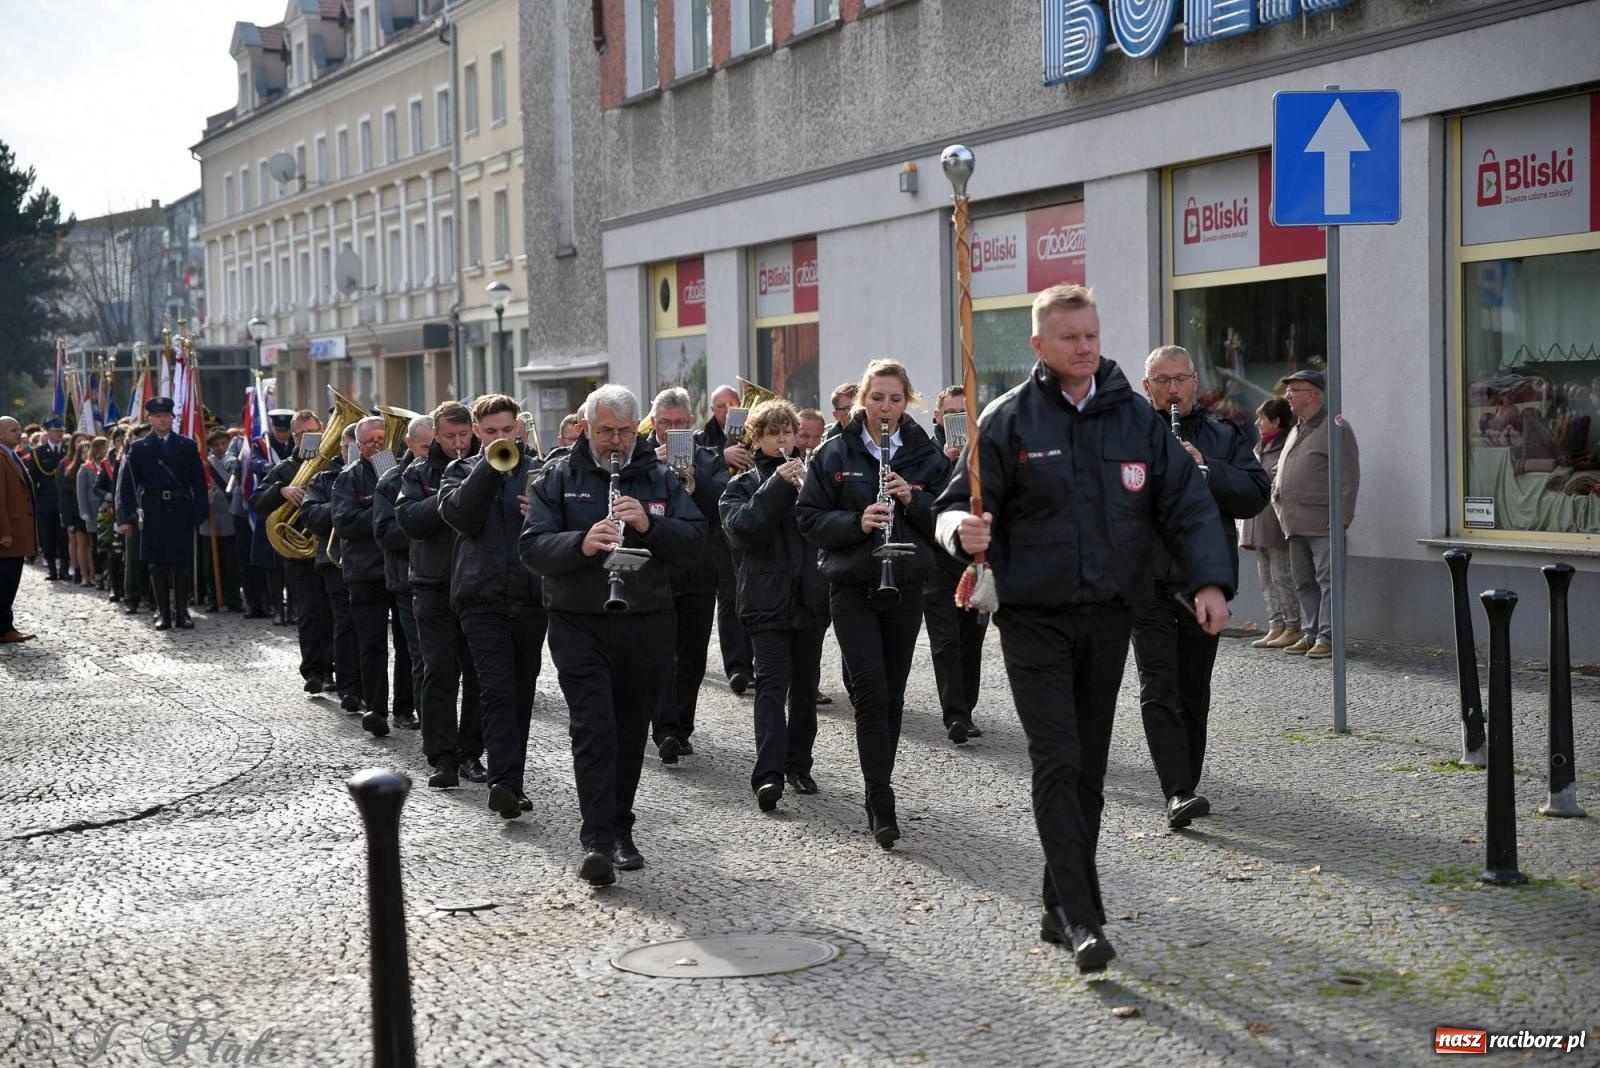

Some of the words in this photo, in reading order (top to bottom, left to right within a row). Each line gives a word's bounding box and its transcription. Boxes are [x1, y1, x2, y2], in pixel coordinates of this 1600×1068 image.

[1505, 147, 1573, 191] Bliski
[1202, 197, 1248, 232] Bliski
[983, 235, 1016, 262] Bliski
[768, 265, 790, 287] Bliski
